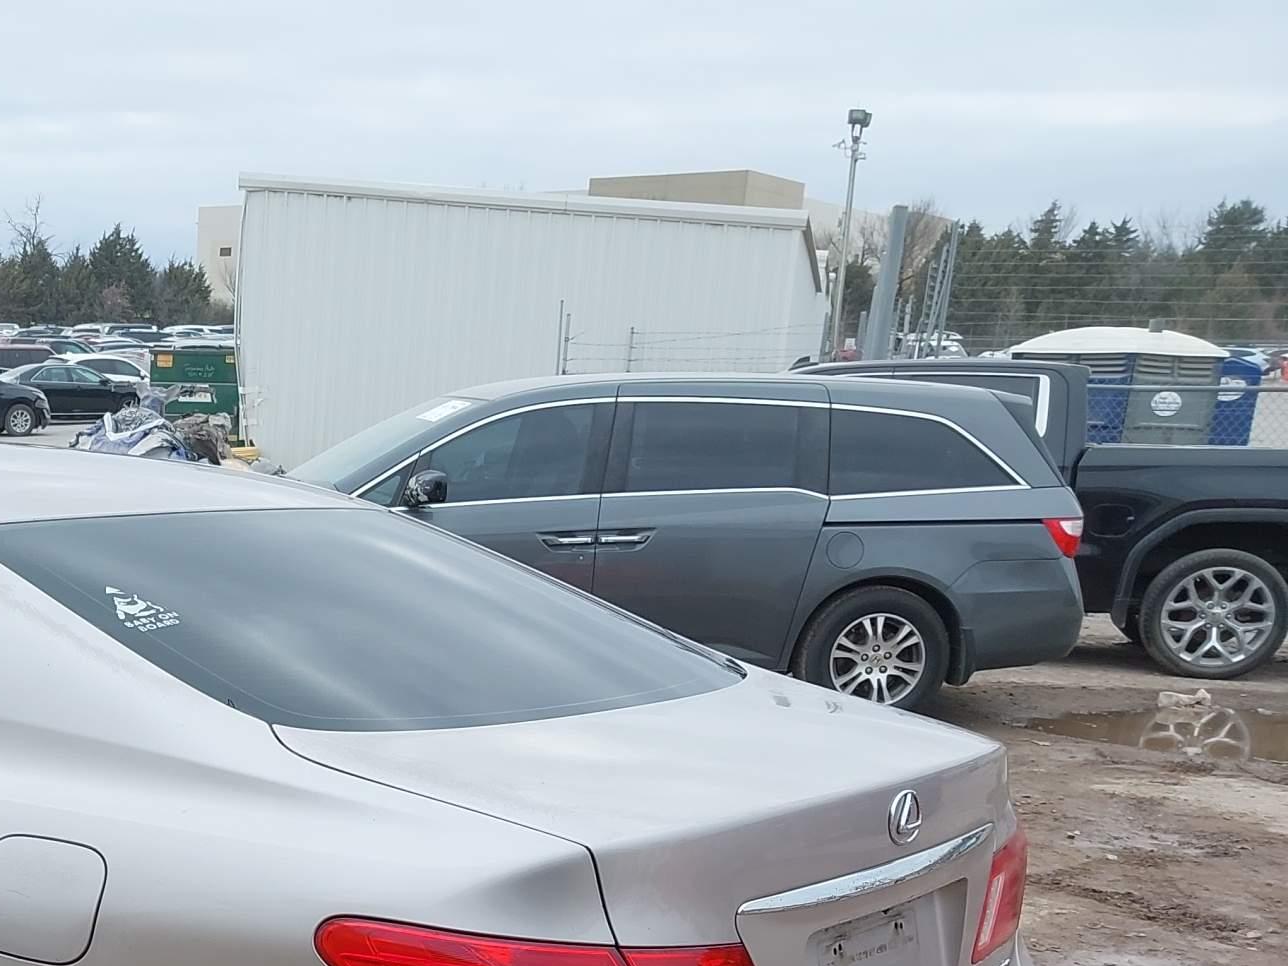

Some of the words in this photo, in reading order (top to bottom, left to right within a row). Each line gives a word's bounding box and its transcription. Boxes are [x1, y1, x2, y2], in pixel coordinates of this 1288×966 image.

[123, 616, 156, 628] BABY
[157, 611, 180, 621] ON
[137, 618, 180, 633] BOARD
